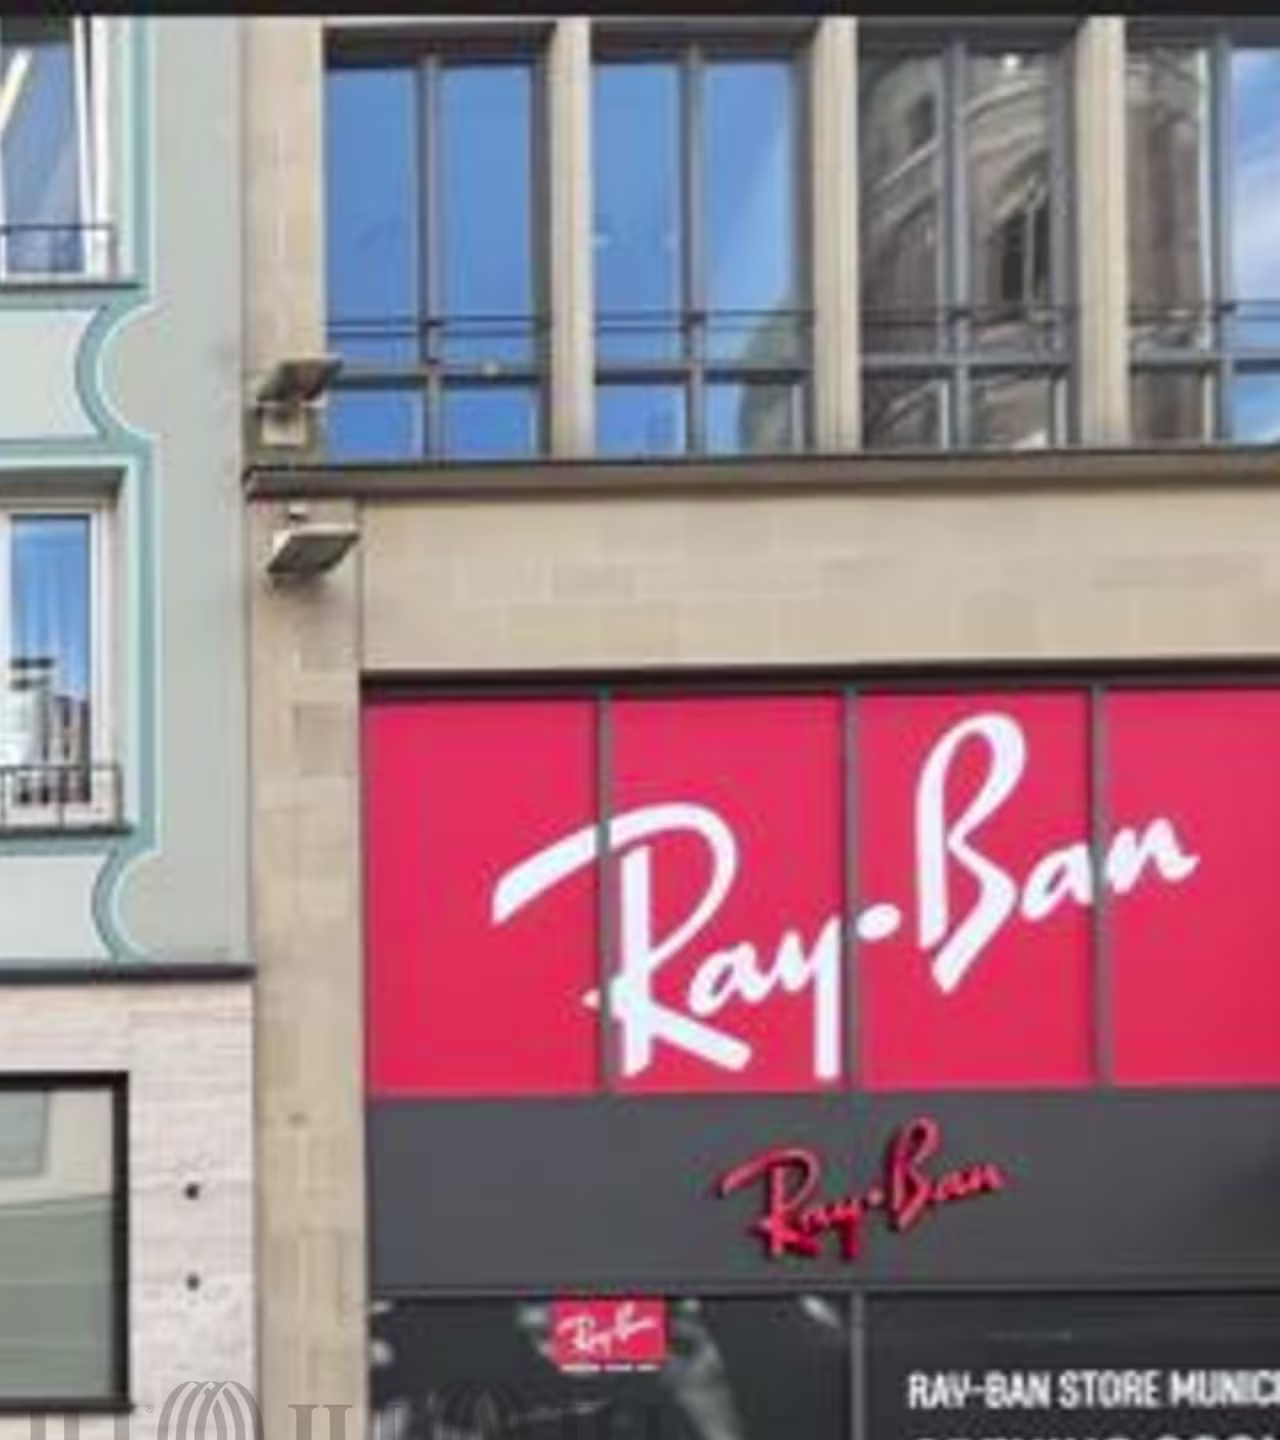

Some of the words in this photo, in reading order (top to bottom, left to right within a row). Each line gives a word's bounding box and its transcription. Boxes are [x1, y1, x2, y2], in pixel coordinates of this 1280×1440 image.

[908, 1369, 1051, 1409] RAY-BAN
[1058, 1368, 1160, 1408] STORE
[1170, 1368, 1280, 1406] MUNIC
